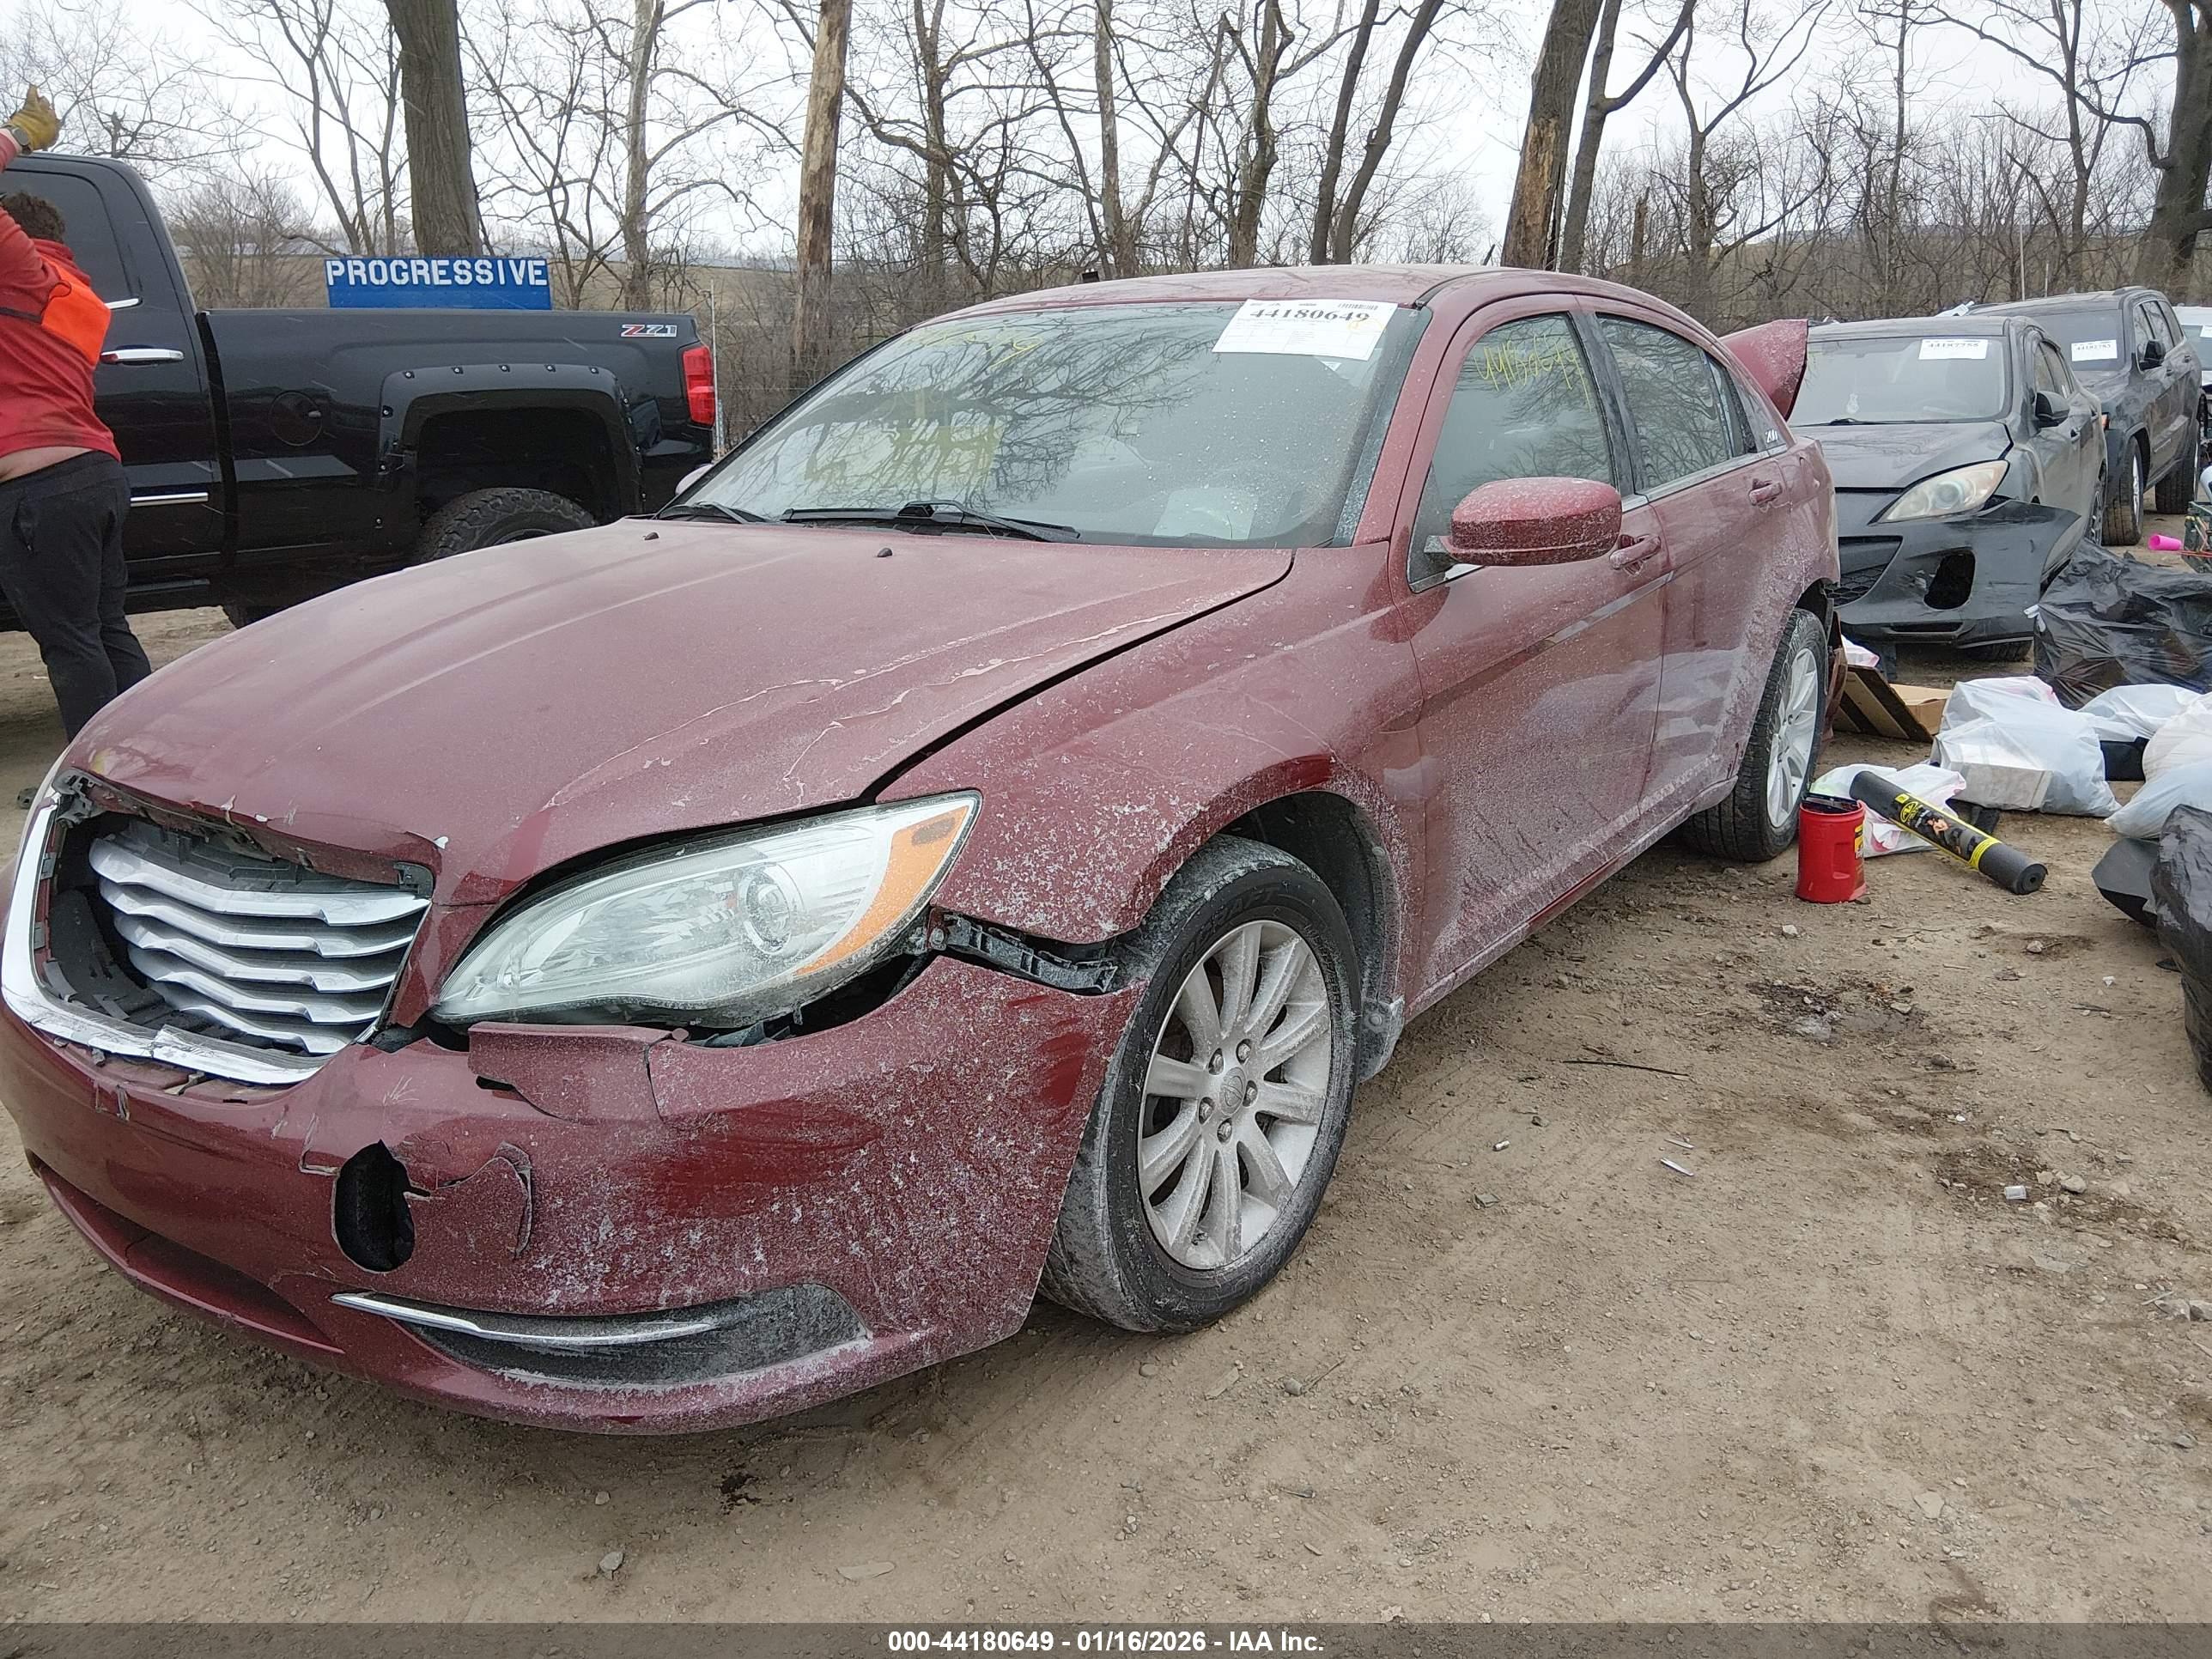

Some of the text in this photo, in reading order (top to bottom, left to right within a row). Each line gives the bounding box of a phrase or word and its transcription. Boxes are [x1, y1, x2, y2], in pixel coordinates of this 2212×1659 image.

[325, 258, 548, 287] PROGRESSIVE
[1249, 307, 1370, 323] 44180649
[620, 324, 678, 337] Z71
